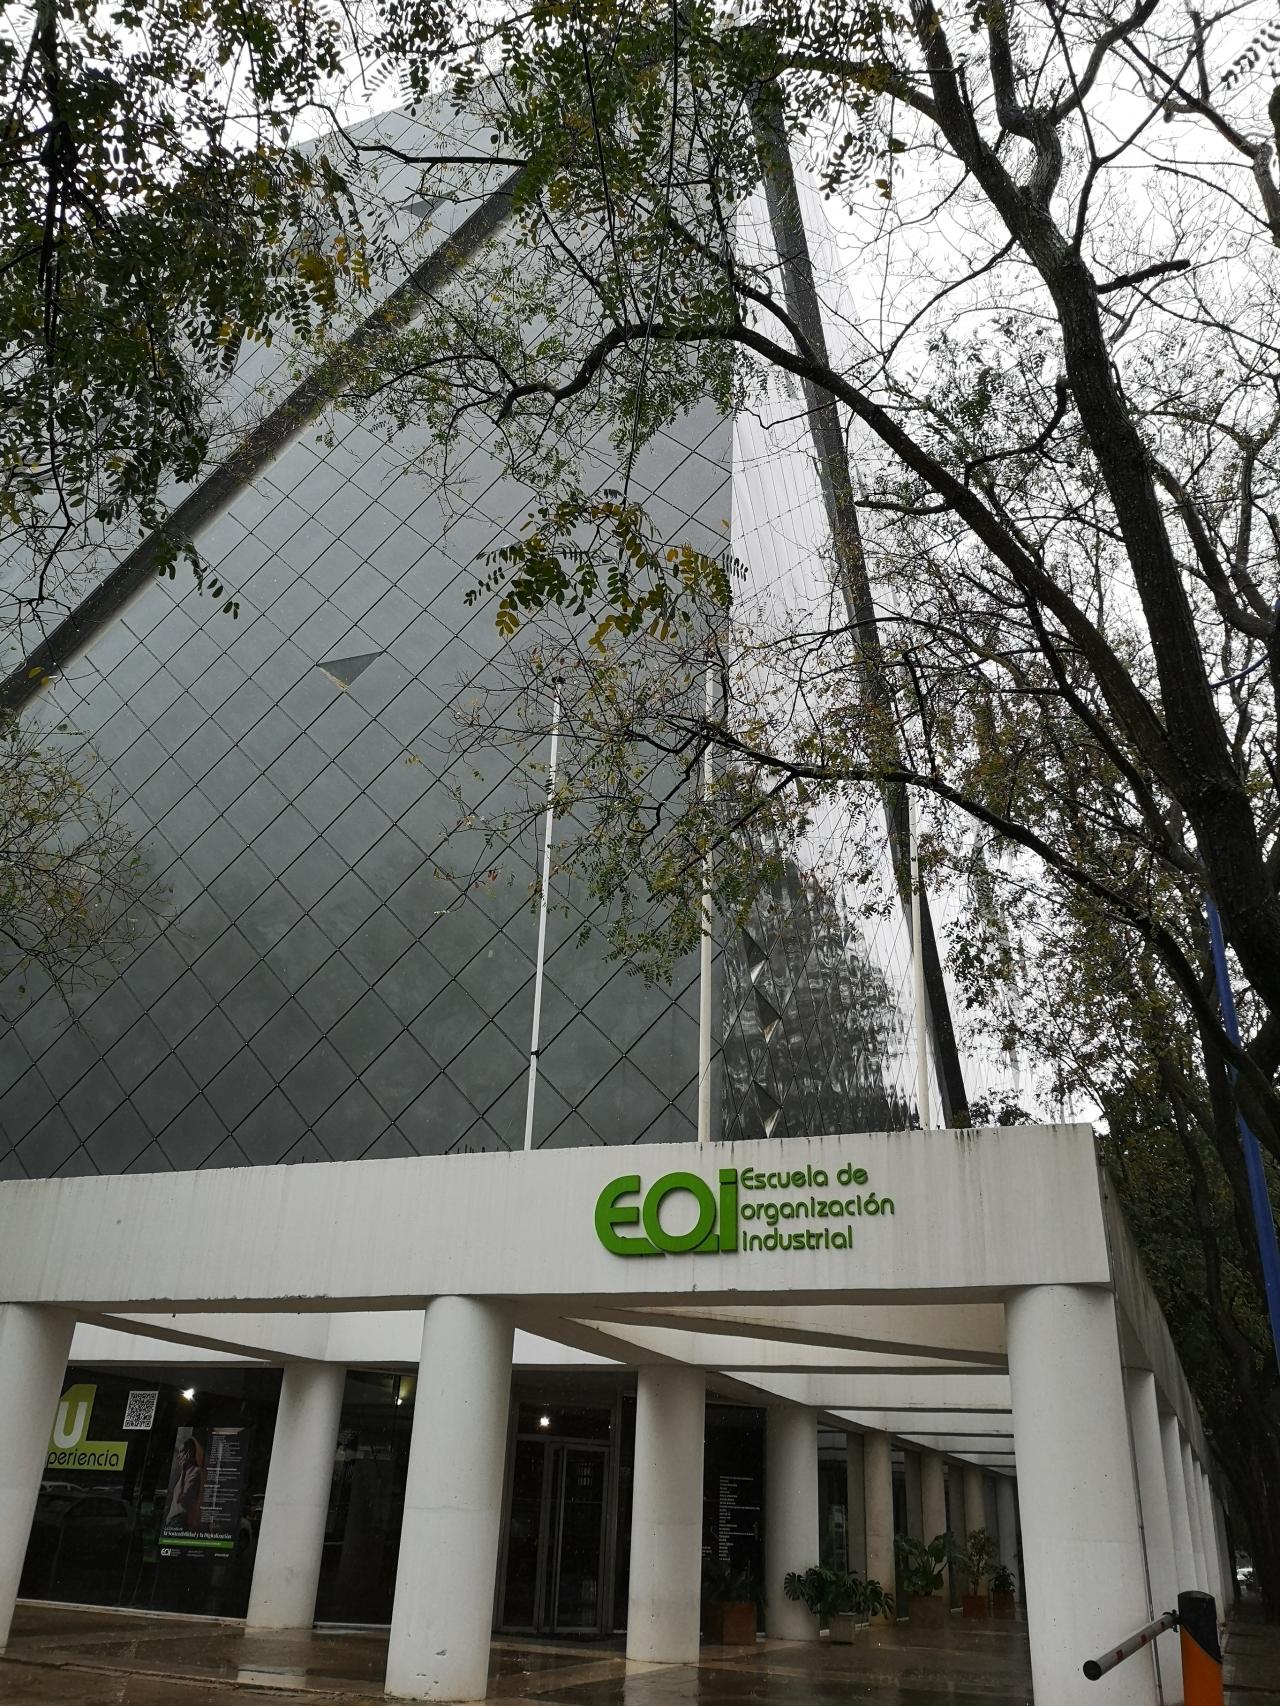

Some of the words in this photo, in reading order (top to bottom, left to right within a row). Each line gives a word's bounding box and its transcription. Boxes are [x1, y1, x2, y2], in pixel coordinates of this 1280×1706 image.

[740, 1164, 829, 1191] Escuela
[836, 1162, 869, 1186] de
[740, 1192, 895, 1226] organización
